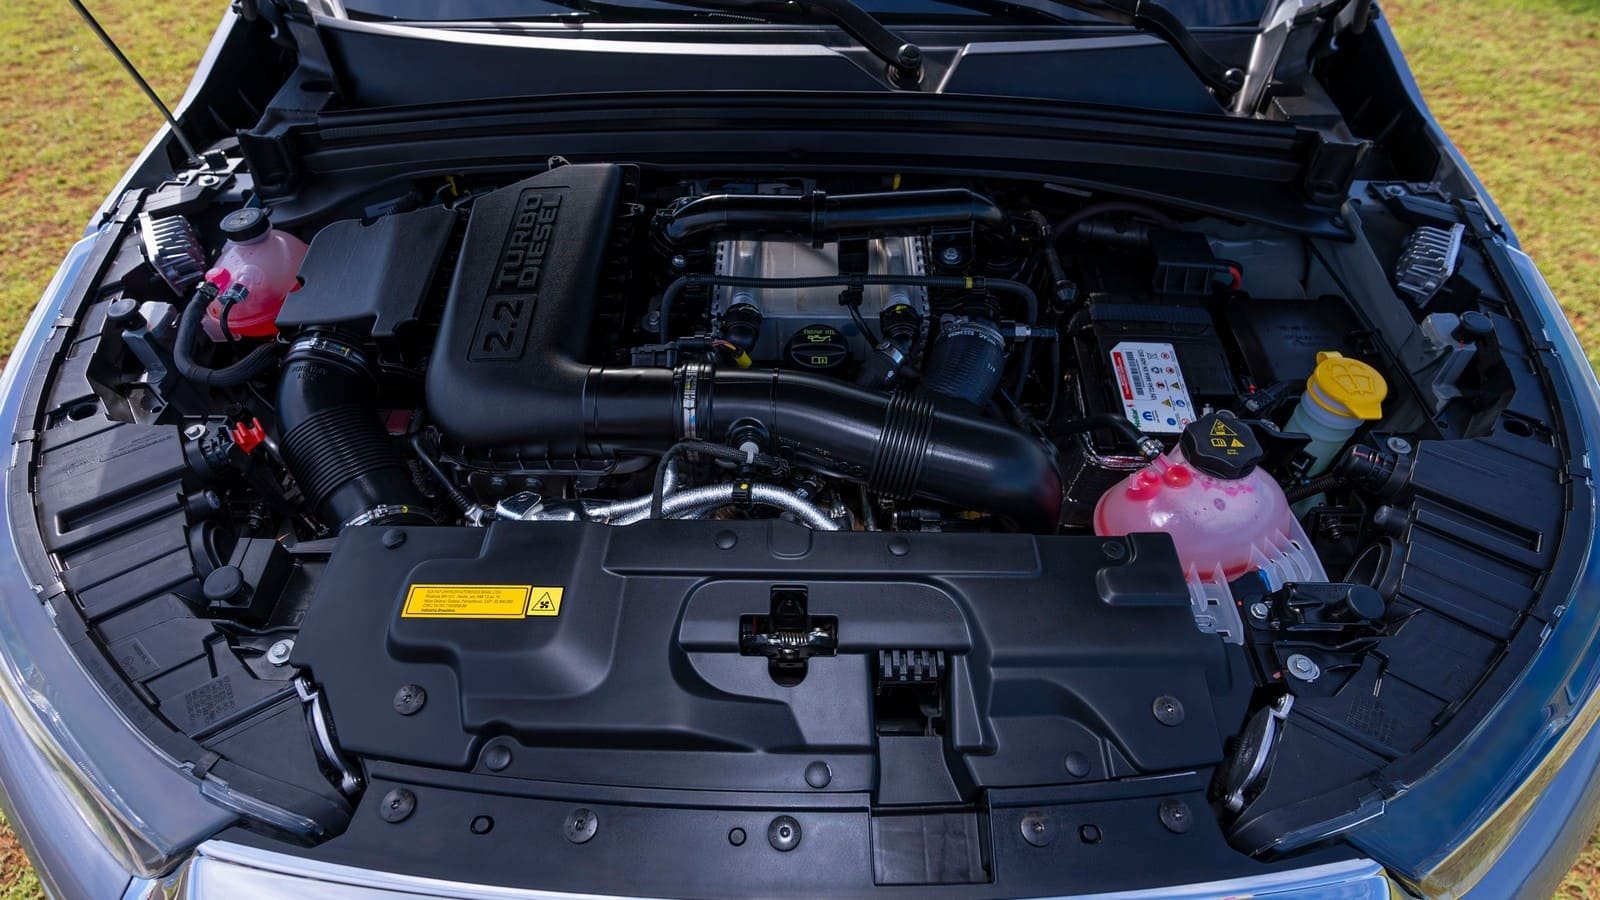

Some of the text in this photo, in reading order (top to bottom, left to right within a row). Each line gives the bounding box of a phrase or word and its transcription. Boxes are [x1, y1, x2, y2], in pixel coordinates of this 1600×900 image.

[497, 193, 543, 291] TURBO
[517, 193, 563, 291] DIESEL
[483, 299, 525, 353] 2.2
